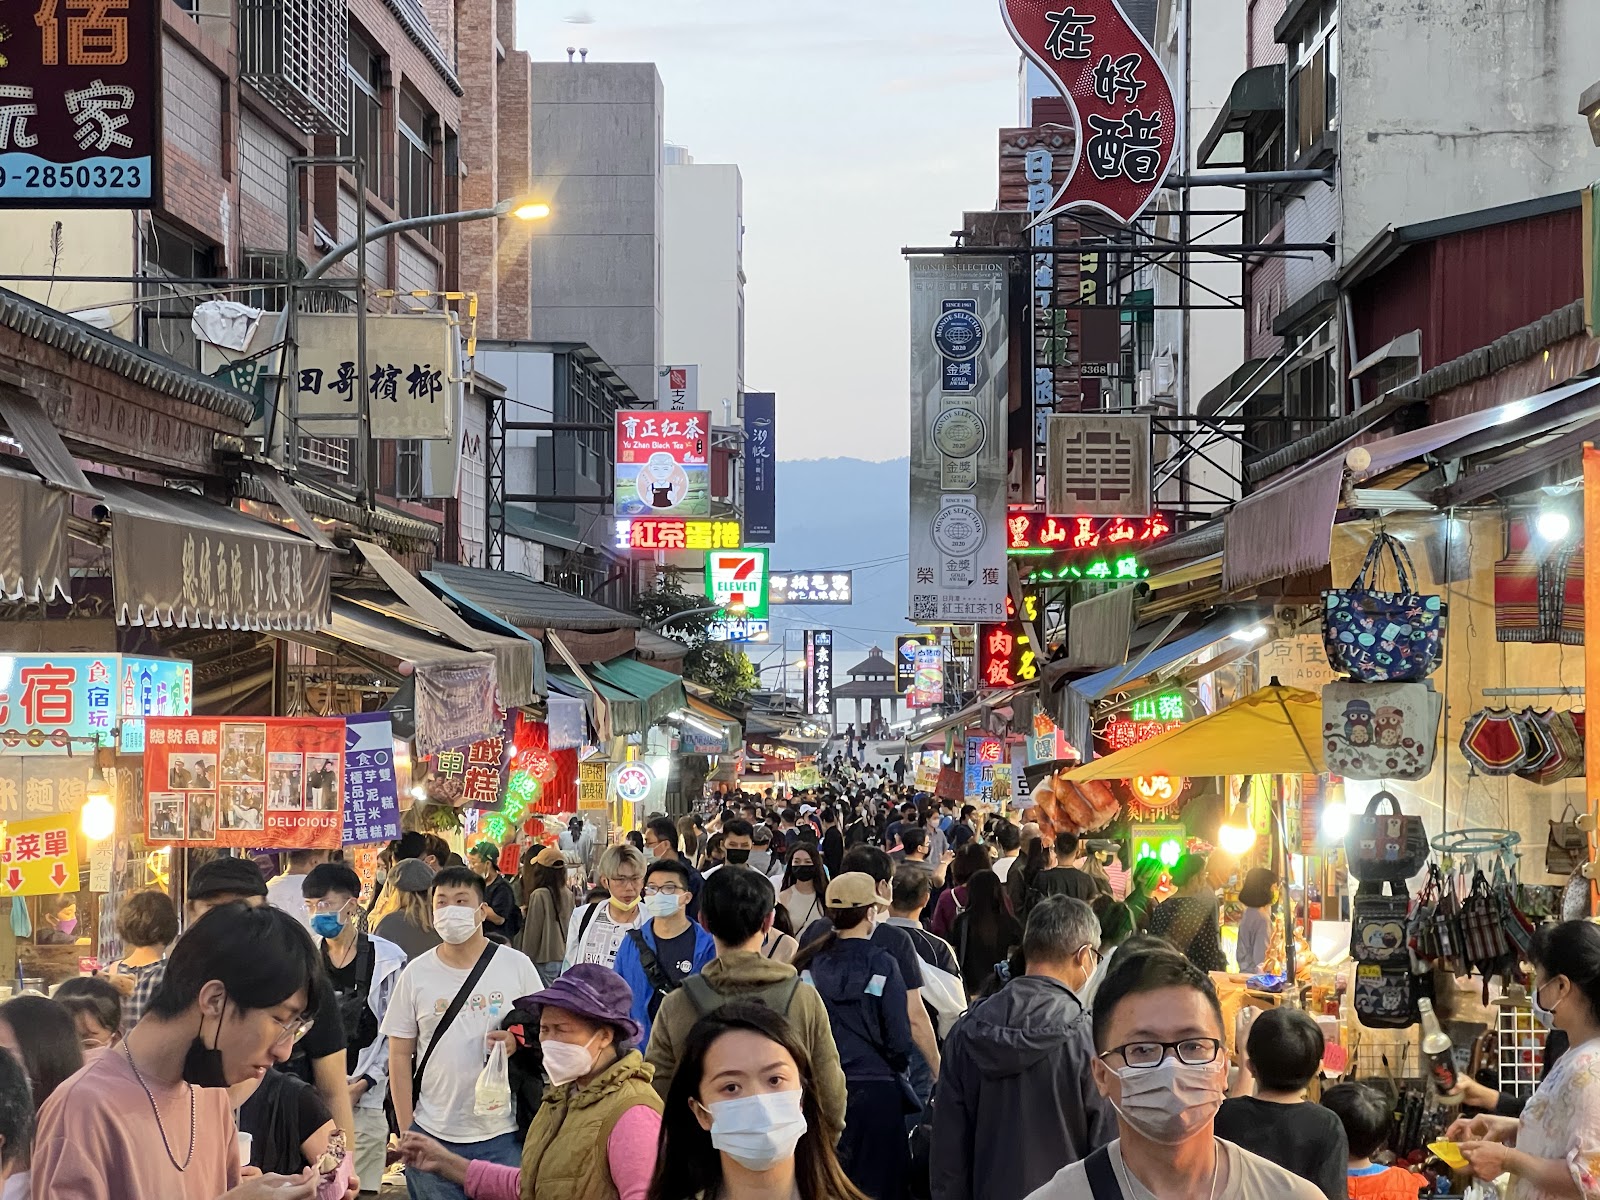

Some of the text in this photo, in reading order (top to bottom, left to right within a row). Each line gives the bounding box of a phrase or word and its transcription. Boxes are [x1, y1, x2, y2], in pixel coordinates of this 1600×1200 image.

[1045, 7, 1163, 183] 在好醋
[936, 312, 982, 338] MONDE SELECTION
[946, 363, 972, 375] 金獎
[936, 411, 981, 435] MONDE SELECTION
[652, 441, 670, 449] Black
[947, 461, 971, 473] 金獎
[935, 508, 981, 533] MONDE SELECTION
[631, 521, 740, 549] 紅茶蛋捲
[917, 567, 999, 585] 榮 獲
[946, 559, 970, 572] 金獎
[719, 557, 755, 603] 7
[942, 603, 1003, 615] 紅玉紅茶18
[0, 662, 76, 726] 宿
[1133, 695, 1184, 721] 山豬
[350, 771, 369, 840] 極品紅豆糕
[364, 769, 383, 839] 芋泥米糕
[268, 817, 338, 828] DELICIOUS
